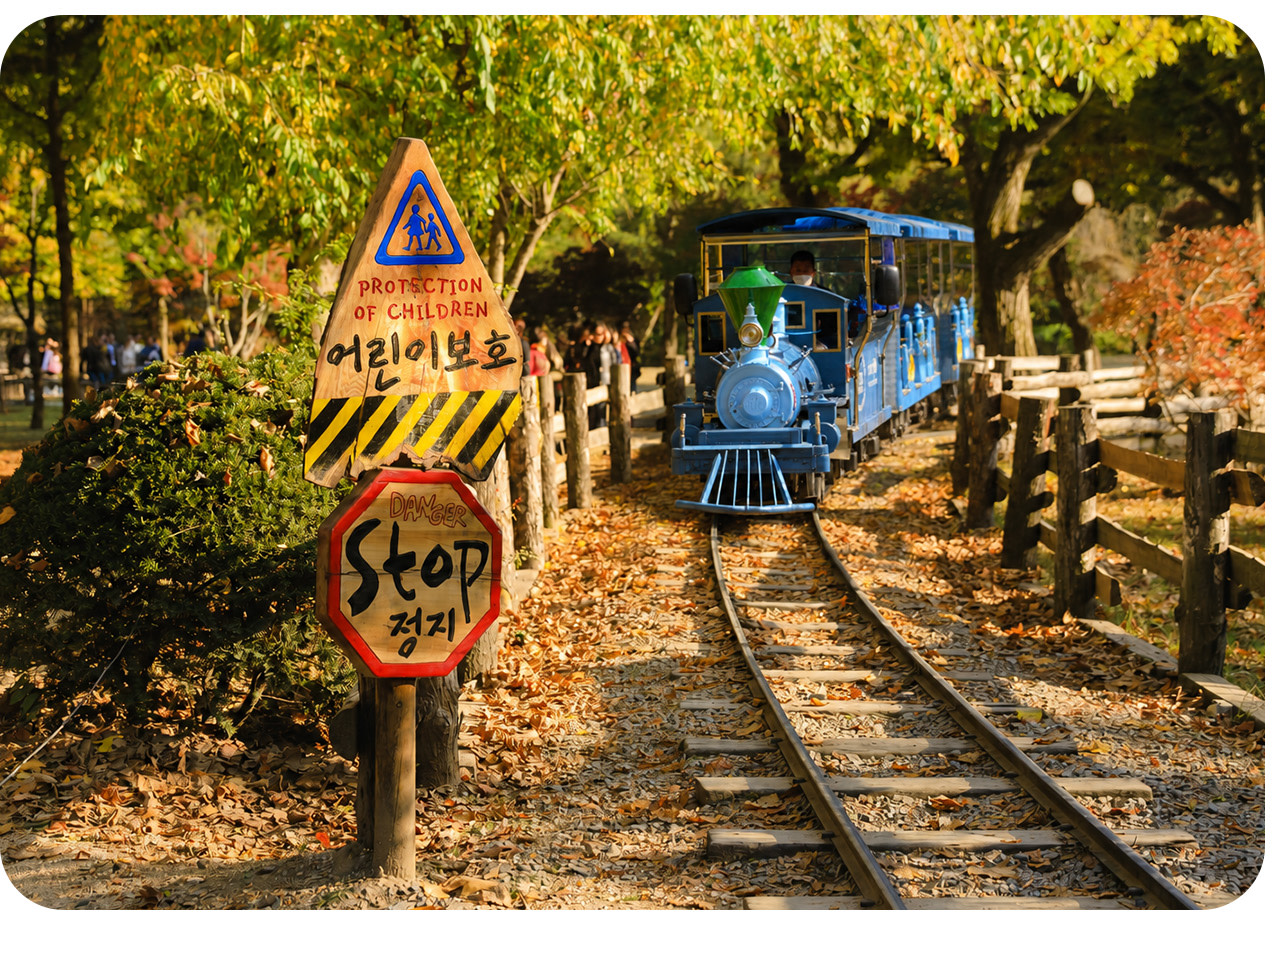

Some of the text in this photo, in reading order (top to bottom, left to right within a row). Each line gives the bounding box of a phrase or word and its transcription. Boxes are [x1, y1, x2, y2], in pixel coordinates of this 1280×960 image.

[357, 277, 483, 297] PROTECTION
[354, 301, 488, 321] OF CHILDREN
[327, 329, 517, 391] 어린이보호
[390, 491, 467, 528] DANGER
[390, 607, 455, 658] 정지
